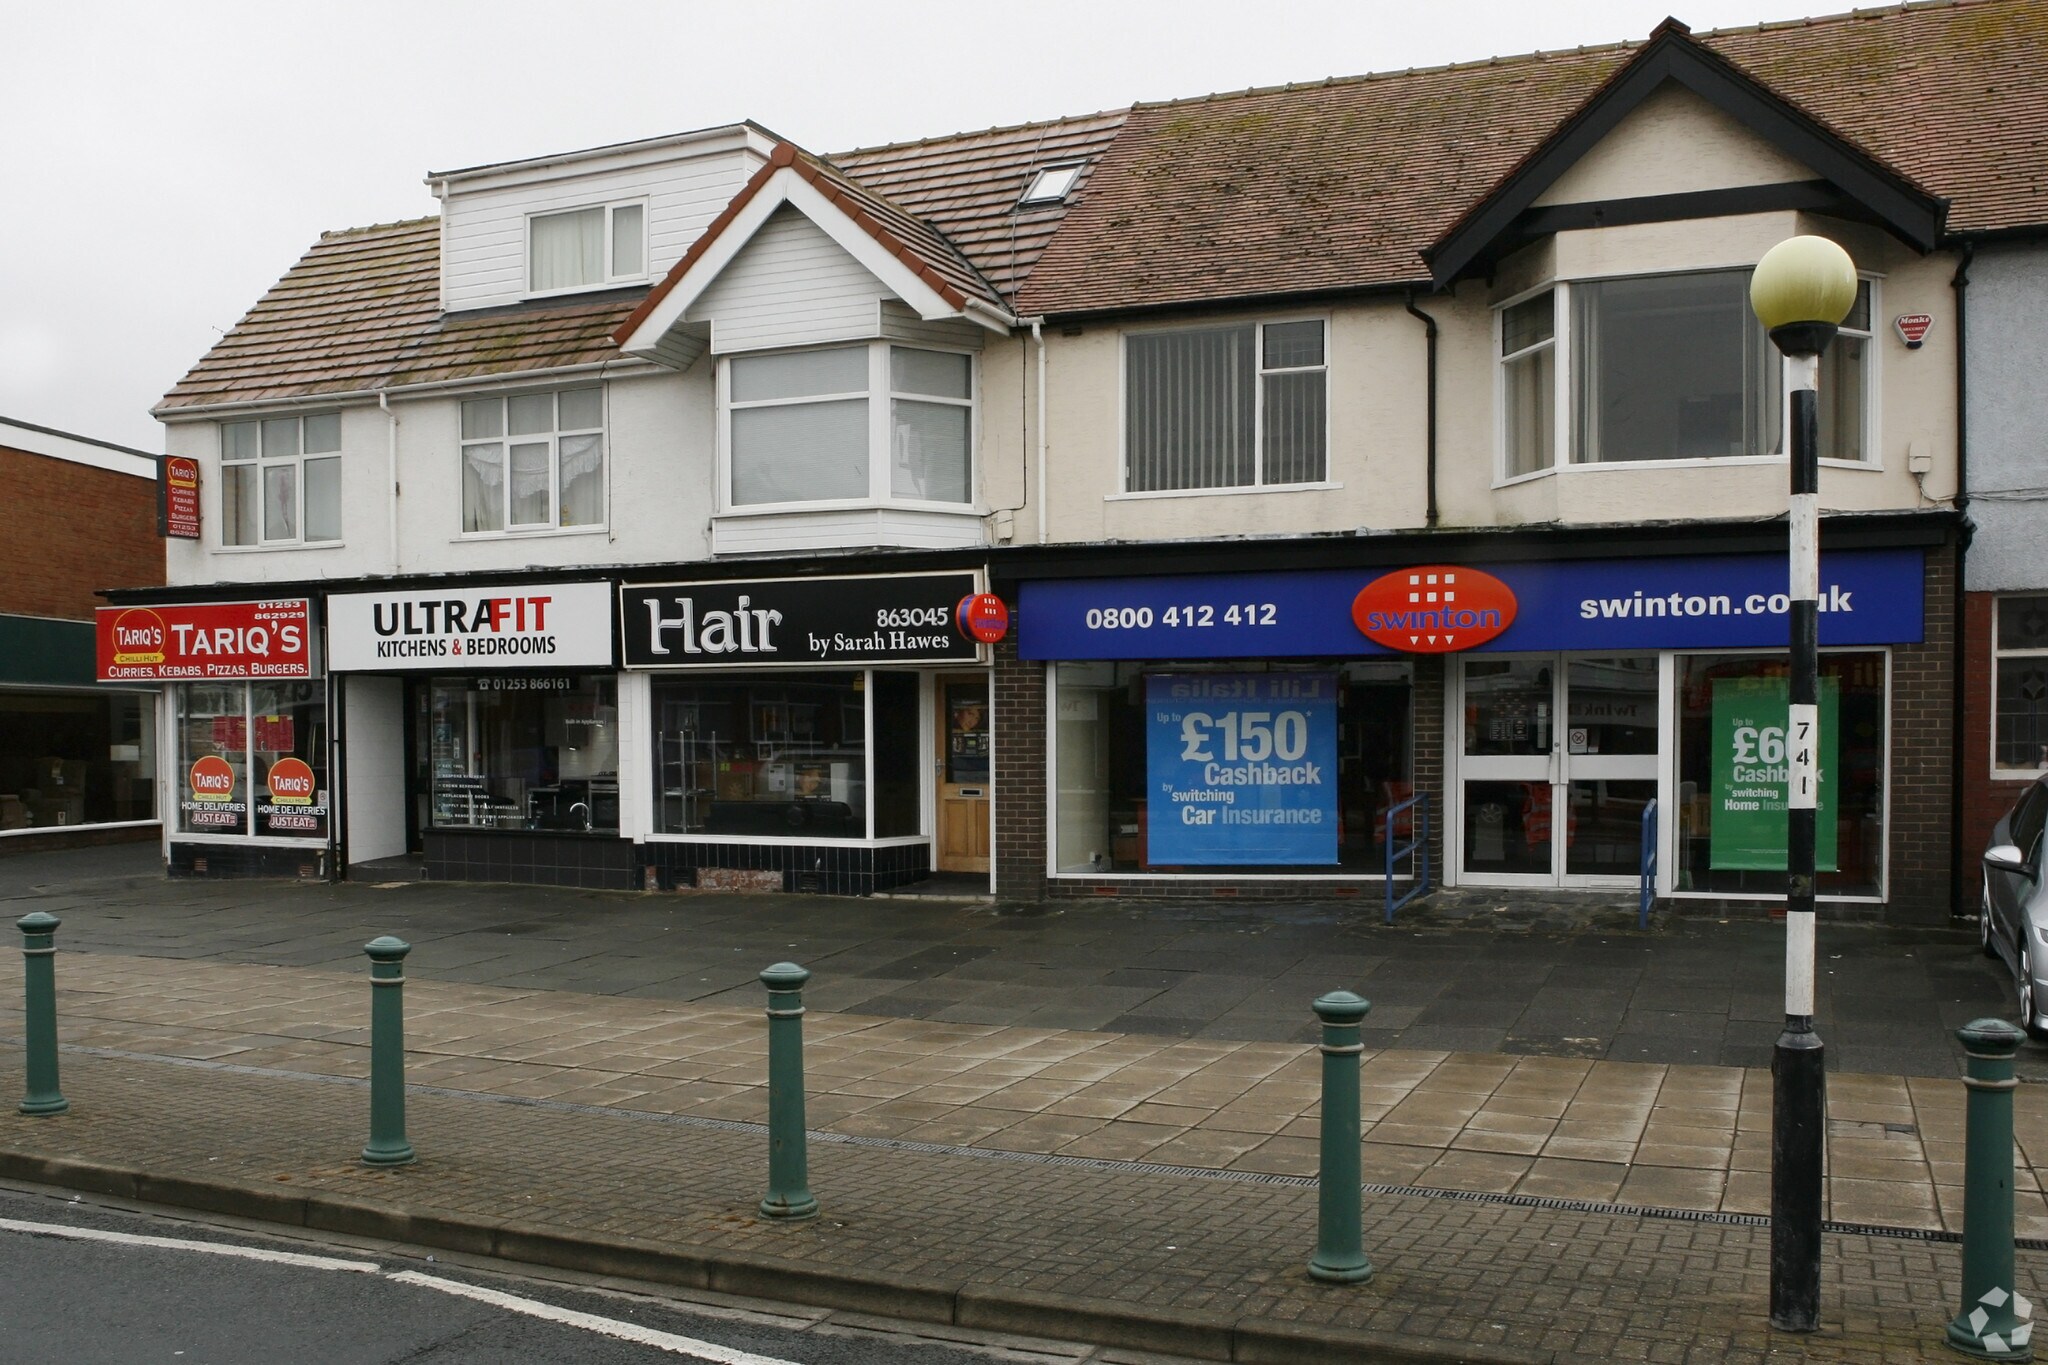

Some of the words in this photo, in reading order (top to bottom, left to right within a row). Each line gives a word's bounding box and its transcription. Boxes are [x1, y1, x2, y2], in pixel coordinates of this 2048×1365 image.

[171, 466, 195, 479] TARIQ'S
[171, 488, 195, 496] CURRIES
[173, 496, 195, 505] KEBABS
[174, 504, 194, 513] PIZZAS
[171, 513, 197, 521] BURGERS
[258, 601, 301, 610] 01253
[1580, 585, 1854, 619] swinton.couk
[254, 611, 305, 620] 862929
[373, 596, 552, 636] ULTRAFIT
[877, 607, 949, 629] 863045
[1086, 606, 1154, 630] 0800
[1162, 604, 1214, 628] 412
[1223, 603, 1277, 627] 412
[1368, 605, 1501, 631] swinton
[643, 595, 783, 656] Hair
[116, 626, 162, 647] TARIQ'S
[171, 620, 301, 658] TARIQ'S
[377, 639, 447, 658] KITCHENS
[452, 639, 462, 656] &
[466, 636, 556, 656] BEDROOMS
[809, 632, 831, 658] by
[834, 632, 886, 652] Sarah
[888, 631, 949, 650] Hawes
[120, 655, 143, 663] CHILLI
[108, 666, 156, 678] CURRIES,
[158, 665, 204, 677] KEBABS,
[207, 663, 249, 676] PIZZAS,
[251, 662, 308, 675] BURGERS.
[493, 678, 527, 690] 01253
[530, 678, 571, 690] 866161
[1157, 712, 1170, 724] Up
[1171, 713, 1181, 722] to
[1732, 718, 1744, 727] Up
[1745, 718, 1754, 726] to
[1732, 726, 1789, 765] £6
[1204, 761, 1322, 786] Cashback
[1733, 764, 1824, 783] Cashbk
[195, 773, 230, 789] TARIQ'S
[273, 776, 309, 792] TARIQ'S
[1162, 783, 1173, 793] by
[1171, 789, 1235, 805] switching
[1731, 788, 1779, 800] switching
[181, 801, 203, 810] HOME
[203, 802, 246, 812] DELIVERIES
[257, 805, 281, 814] HOME
[281, 806, 326, 816] DELIVERIES
[1724, 799, 1760, 811] Home
[1763, 799, 1824, 811] Insue
[193, 813, 214, 822] JUST
[215, 814, 231, 824] EAT
[271, 816, 293, 827] JUST
[293, 817, 310, 827] EAT
[1182, 805, 1216, 825] Car
[1222, 806, 1322, 825] Insurance
